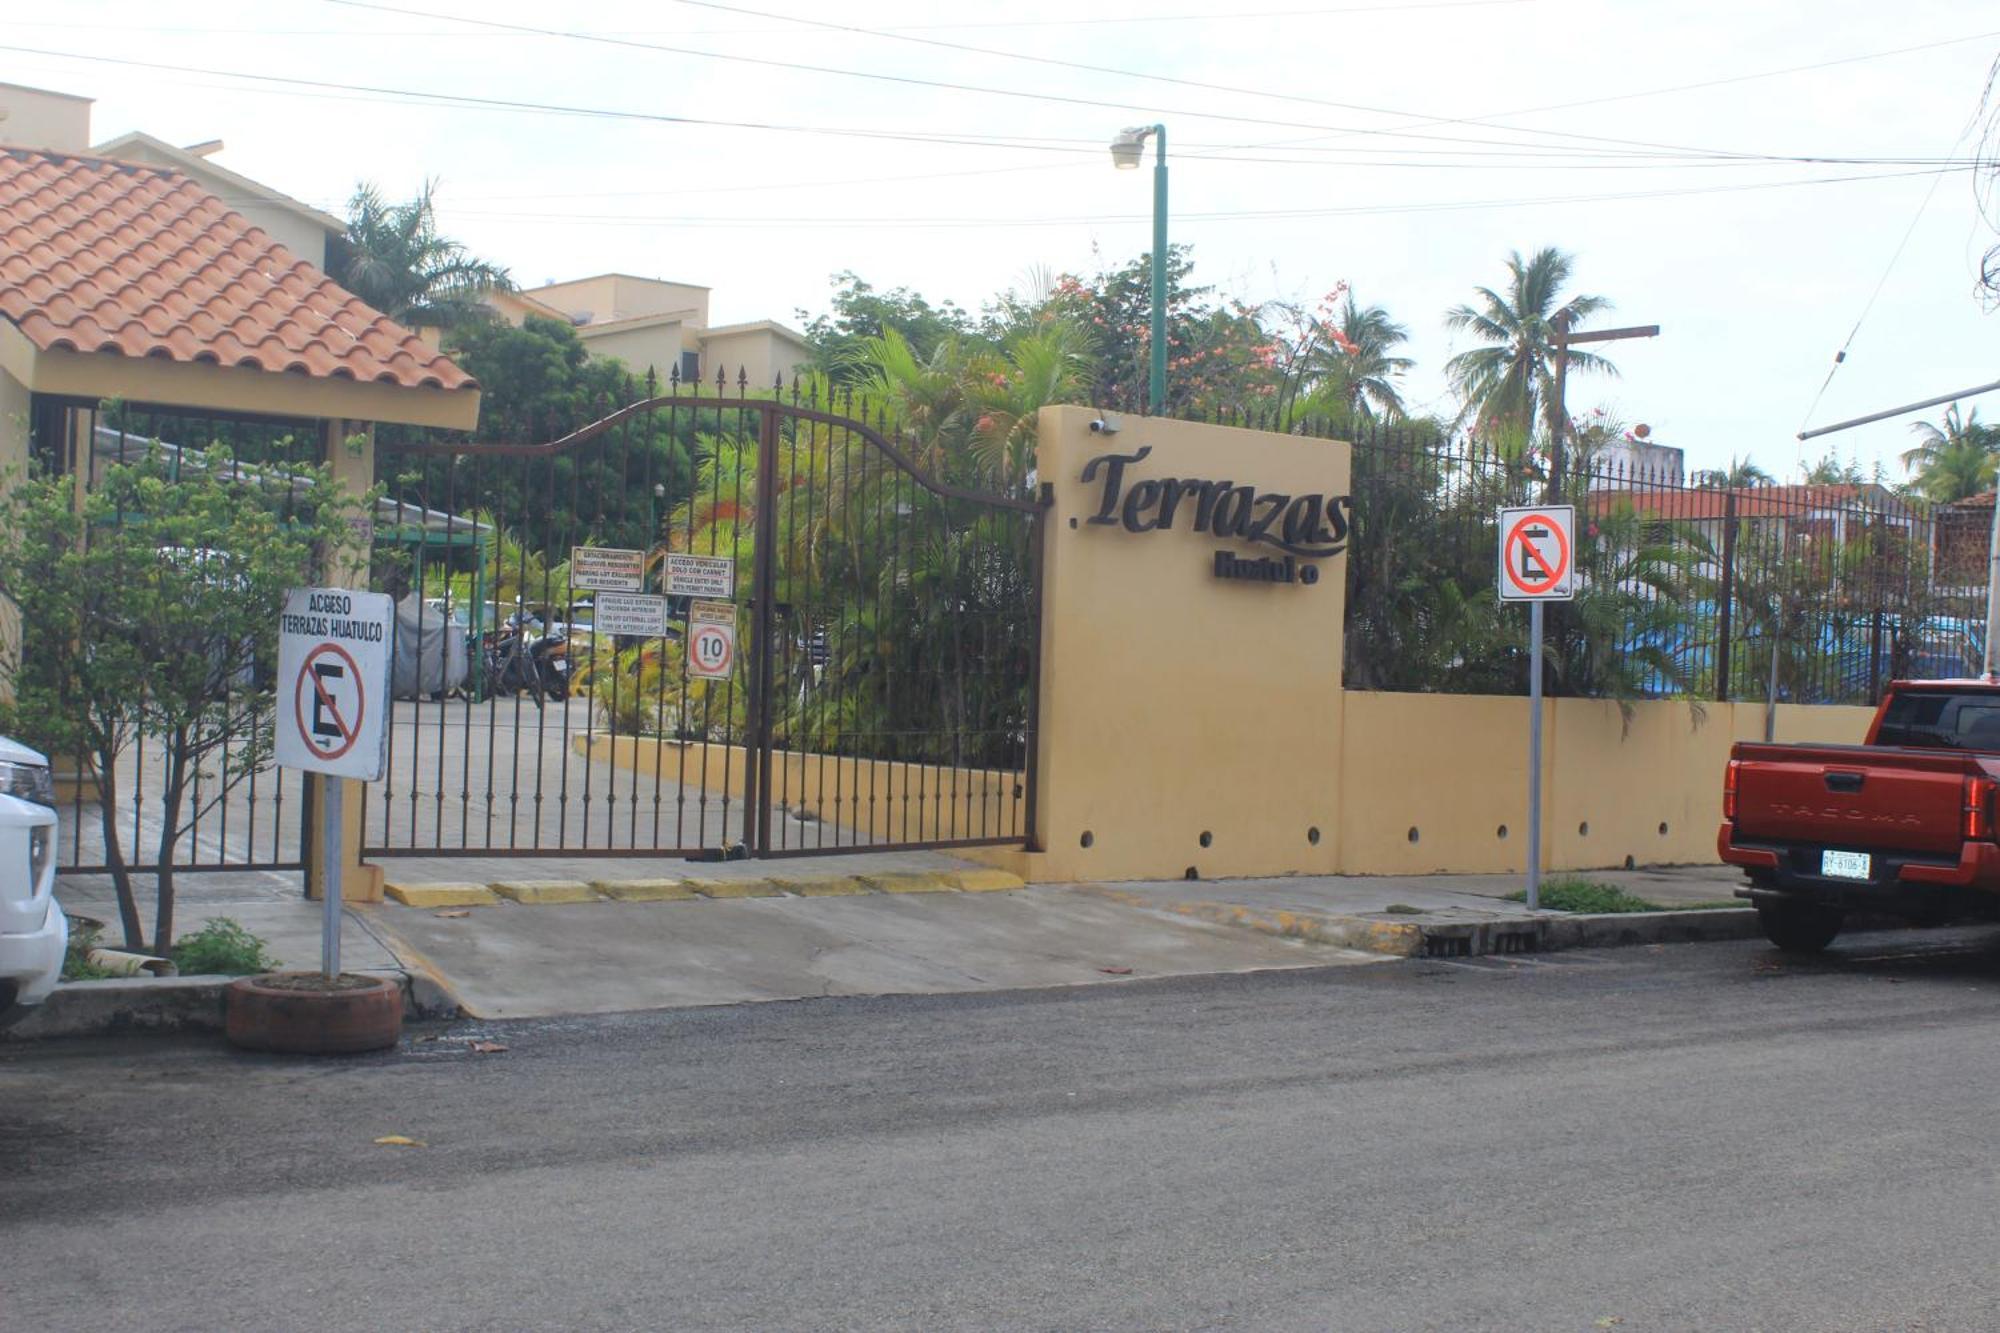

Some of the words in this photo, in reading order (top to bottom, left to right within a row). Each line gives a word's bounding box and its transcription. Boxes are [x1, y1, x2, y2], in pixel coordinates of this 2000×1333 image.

[1081, 446, 1352, 557] Terrazas
[309, 594, 350, 615] ACCESO
[282, 614, 328, 637] TERRAZAS
[331, 619, 383, 642] HUATULCO
[702, 637, 723, 657] 10
[1769, 802, 1921, 825] TACOMA
